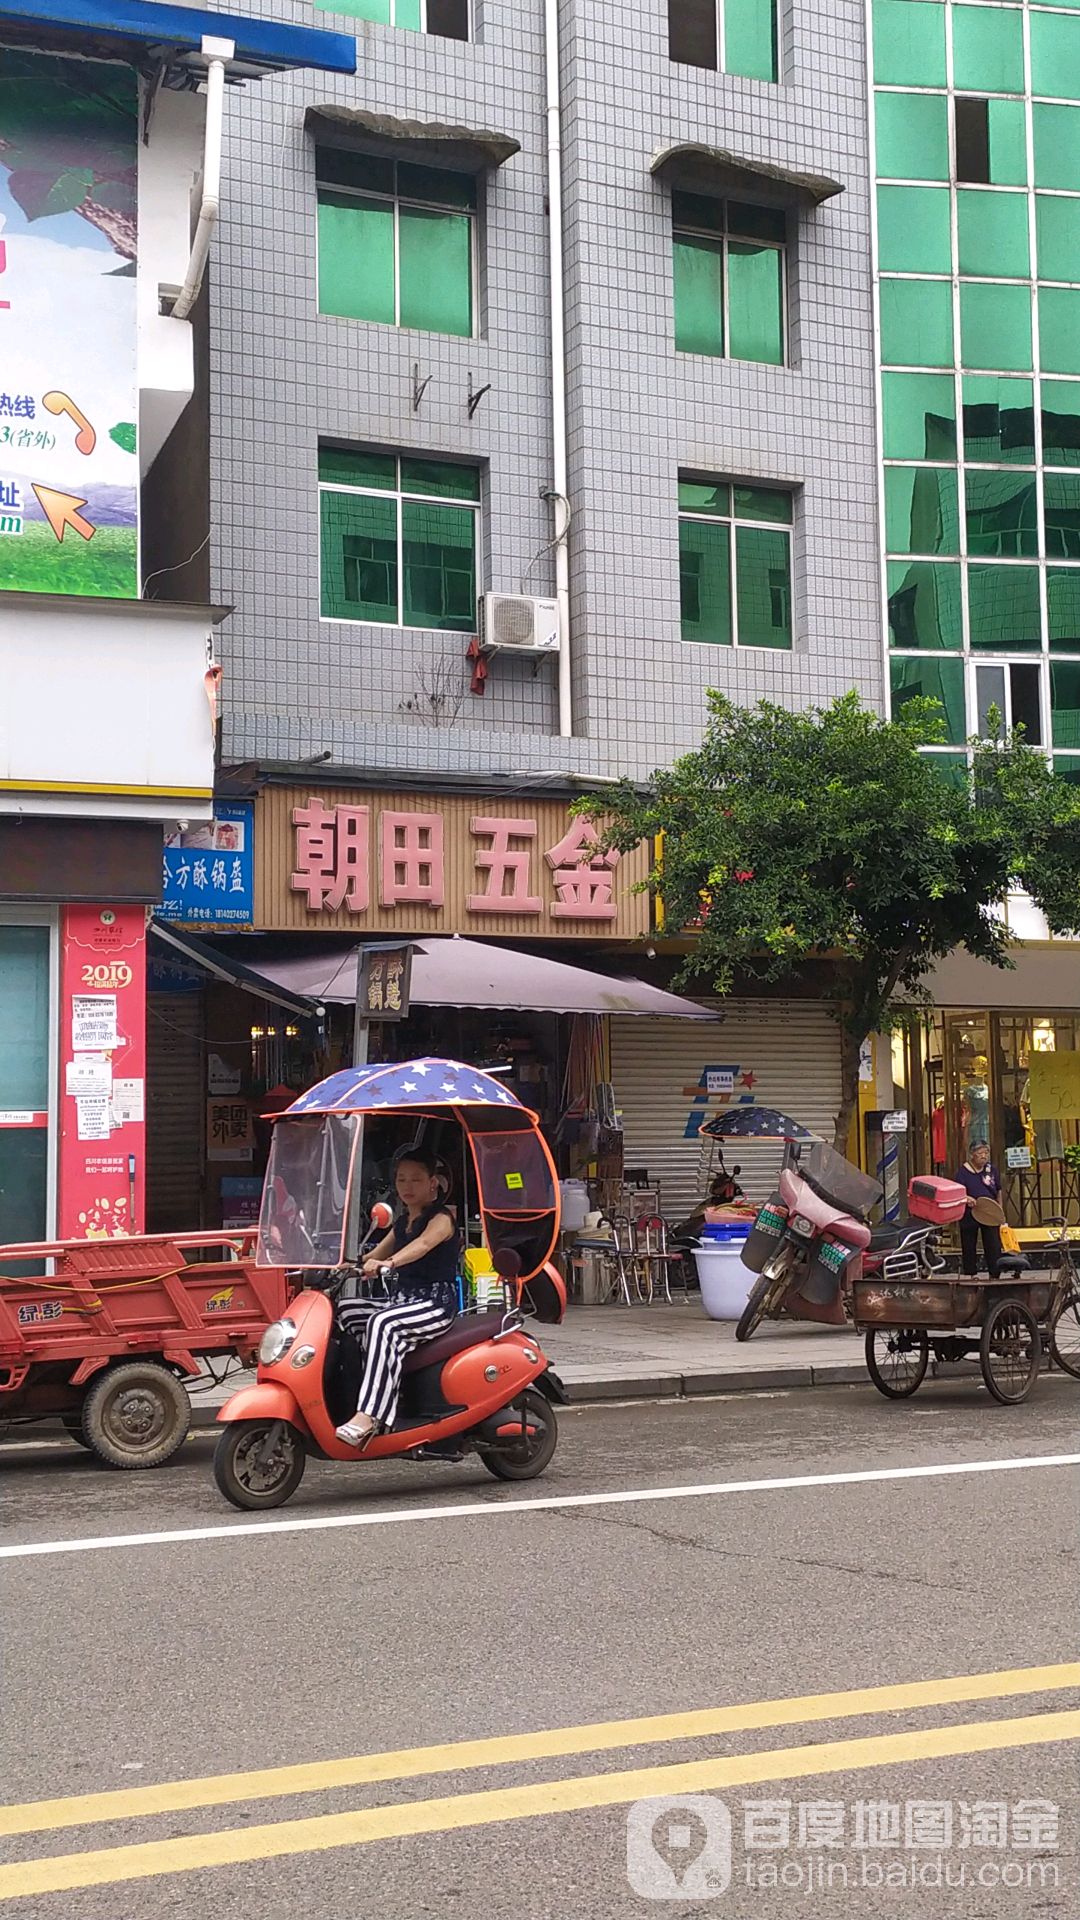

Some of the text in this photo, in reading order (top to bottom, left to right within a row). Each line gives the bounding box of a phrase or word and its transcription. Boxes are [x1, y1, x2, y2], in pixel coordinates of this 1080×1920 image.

[291, 797, 621, 919] 朝田五金
[81, 965, 132, 988] 2019
[211, 1105, 248, 1121] 美团
[212, 1120, 248, 1144] 外卖
